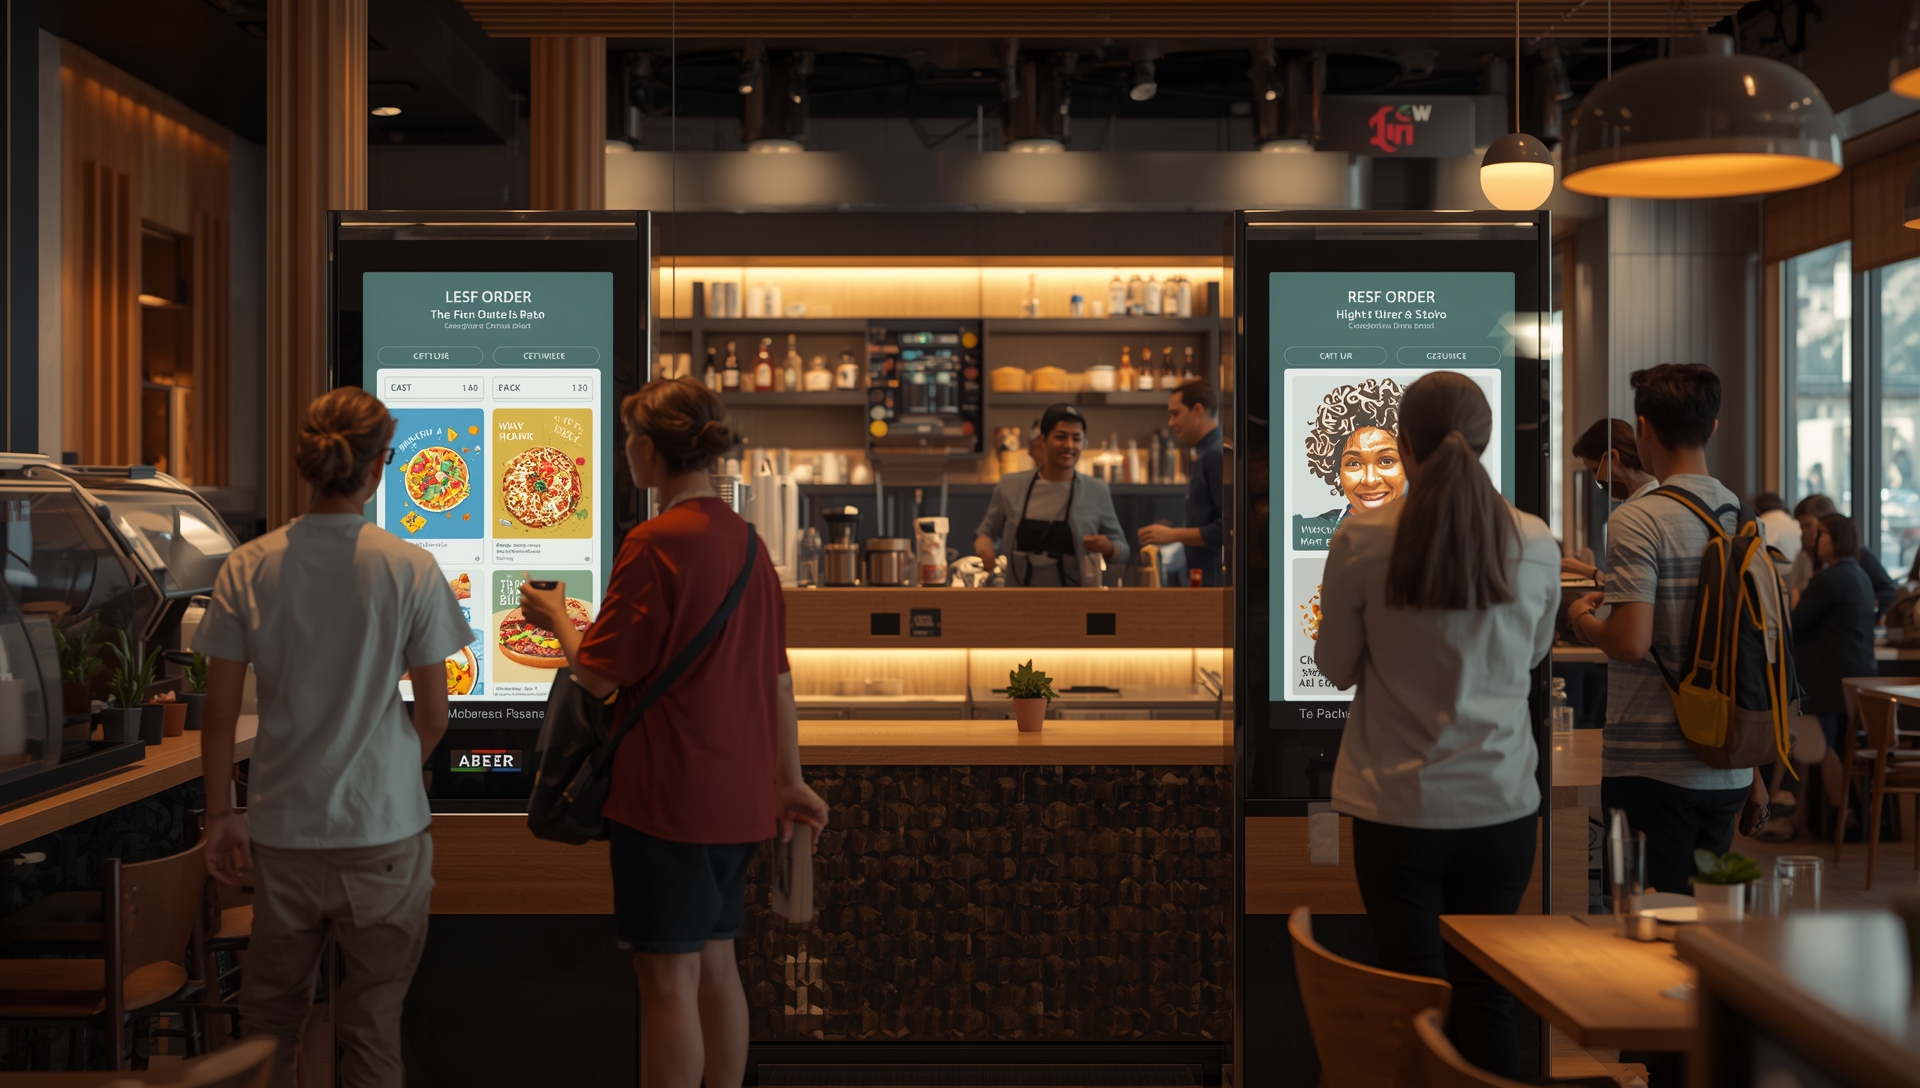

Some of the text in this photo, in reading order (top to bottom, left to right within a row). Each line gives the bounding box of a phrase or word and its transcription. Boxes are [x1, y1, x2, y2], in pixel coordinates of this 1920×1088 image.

[445, 290, 532, 304] LESF ORDER
[1348, 290, 1436, 304] RESF ORDER
[430, 309, 451, 320] The
[1298, 708, 1314, 719] Te
[458, 754, 514, 768] ABEER
